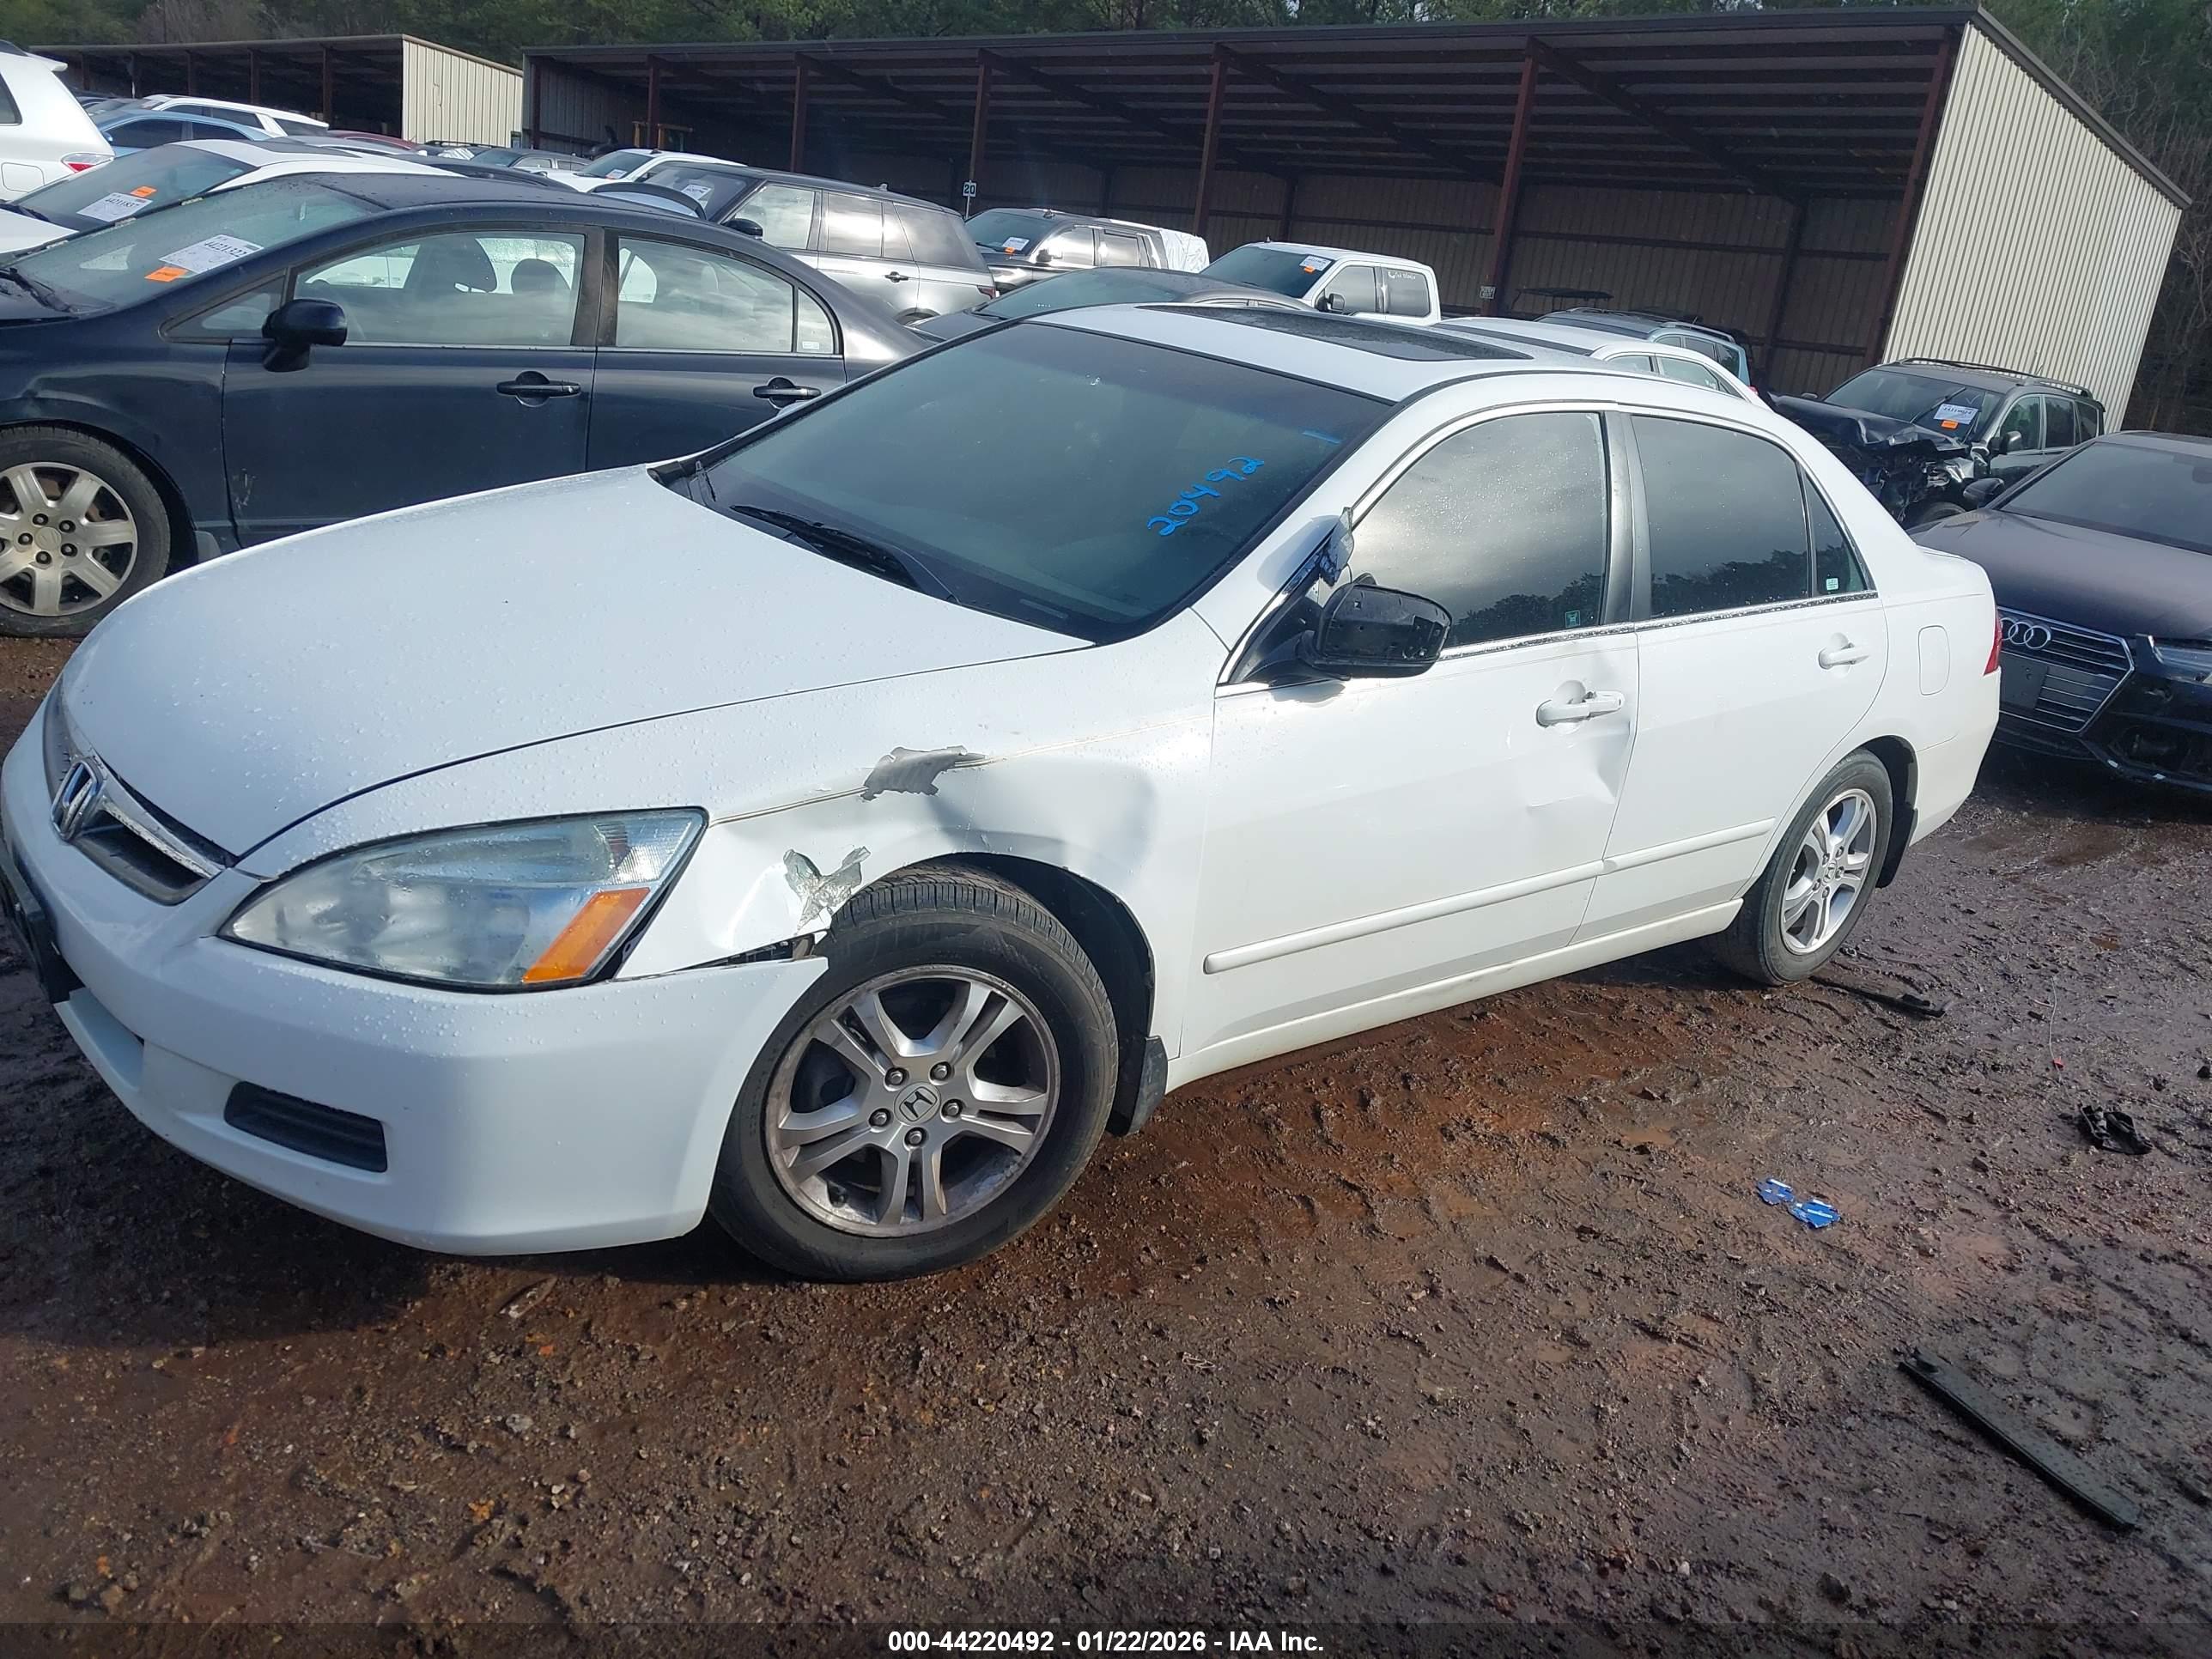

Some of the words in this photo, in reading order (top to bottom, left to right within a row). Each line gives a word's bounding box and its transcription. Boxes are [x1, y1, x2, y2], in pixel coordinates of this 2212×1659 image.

[963, 184, 975, 195] 20
[204, 240, 247, 258] 44221322
[1147, 455, 1265, 537] 20492
